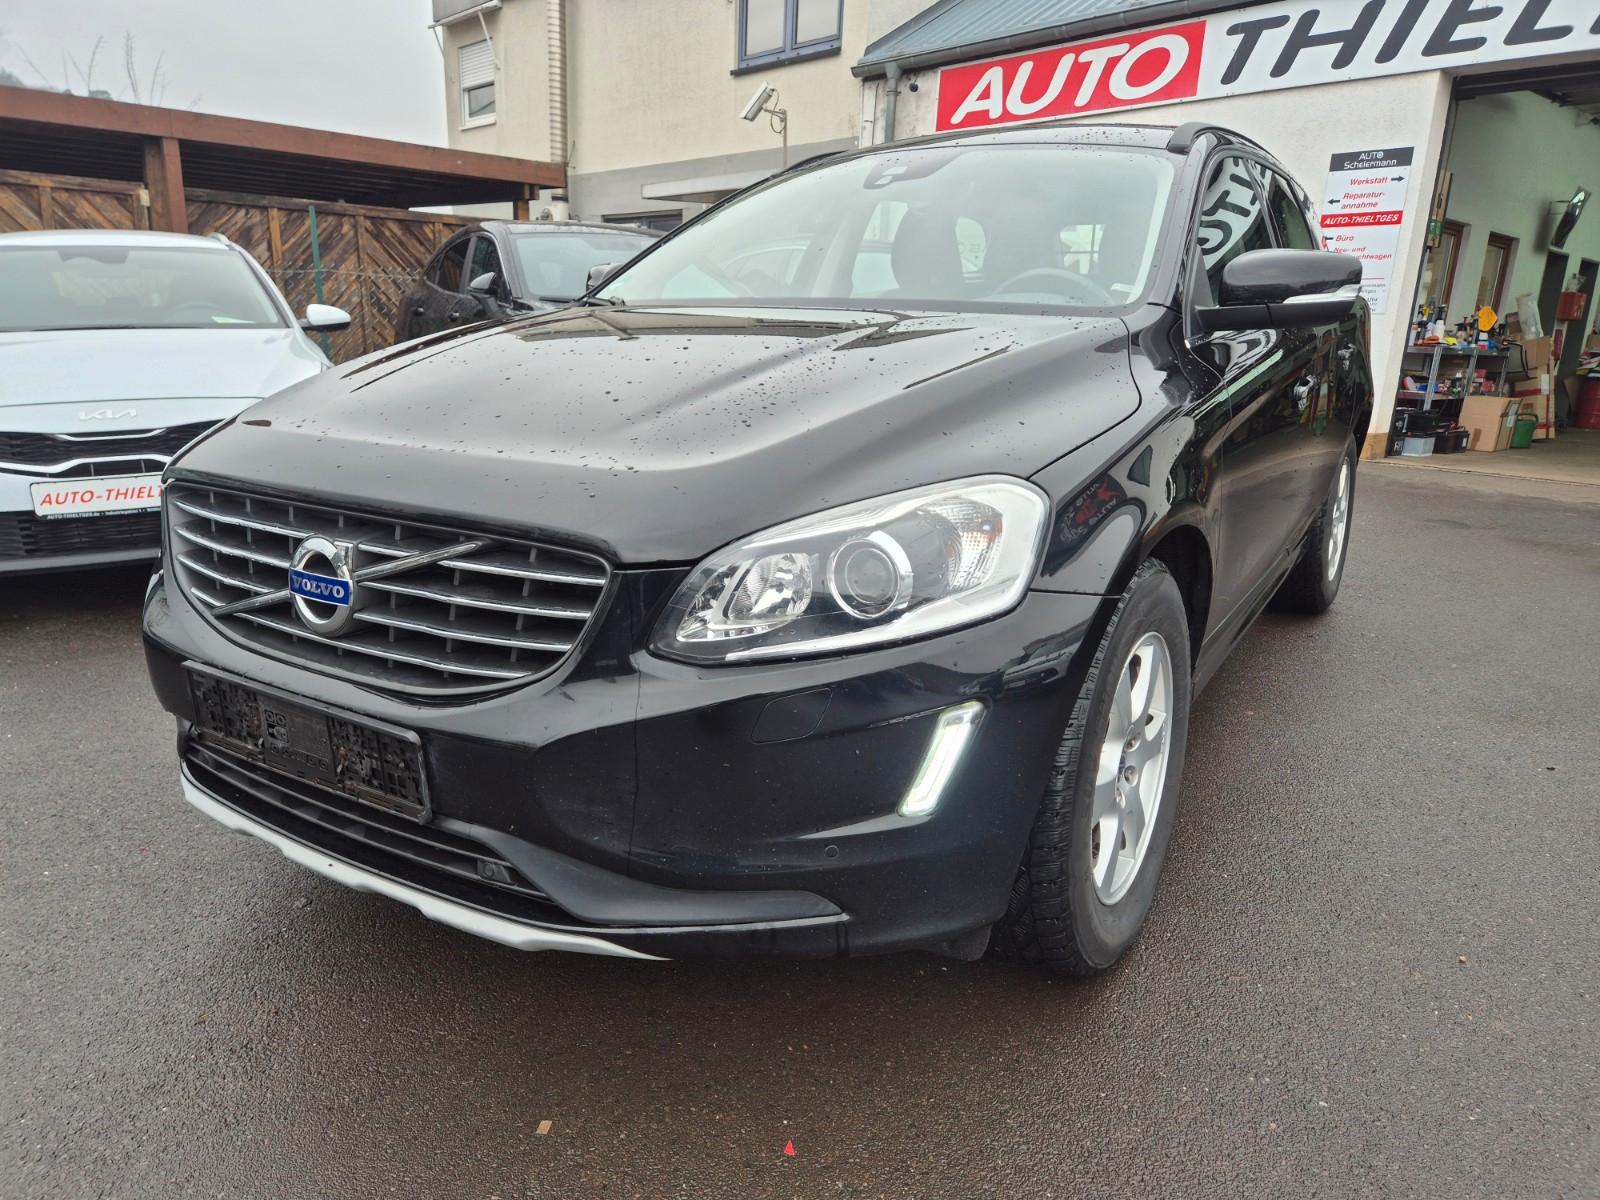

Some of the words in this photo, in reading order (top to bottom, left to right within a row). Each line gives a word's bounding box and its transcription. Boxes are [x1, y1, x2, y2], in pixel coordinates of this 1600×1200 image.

[950, 34, 1190, 125] AUTO
[1220, 0, 1600, 86] THIEL
[1358, 151, 1384, 161] AUTO
[1350, 176, 1388, 186] Werkstatt
[1343, 191, 1385, 201] Reparatur-
[1341, 202, 1378, 210] annahme
[1323, 214, 1399, 225] AUTO-THIELTGES
[1335, 234, 1354, 242] Büro
[80, 408, 137, 420] KIA
[291, 574, 345, 598] VOLVO
